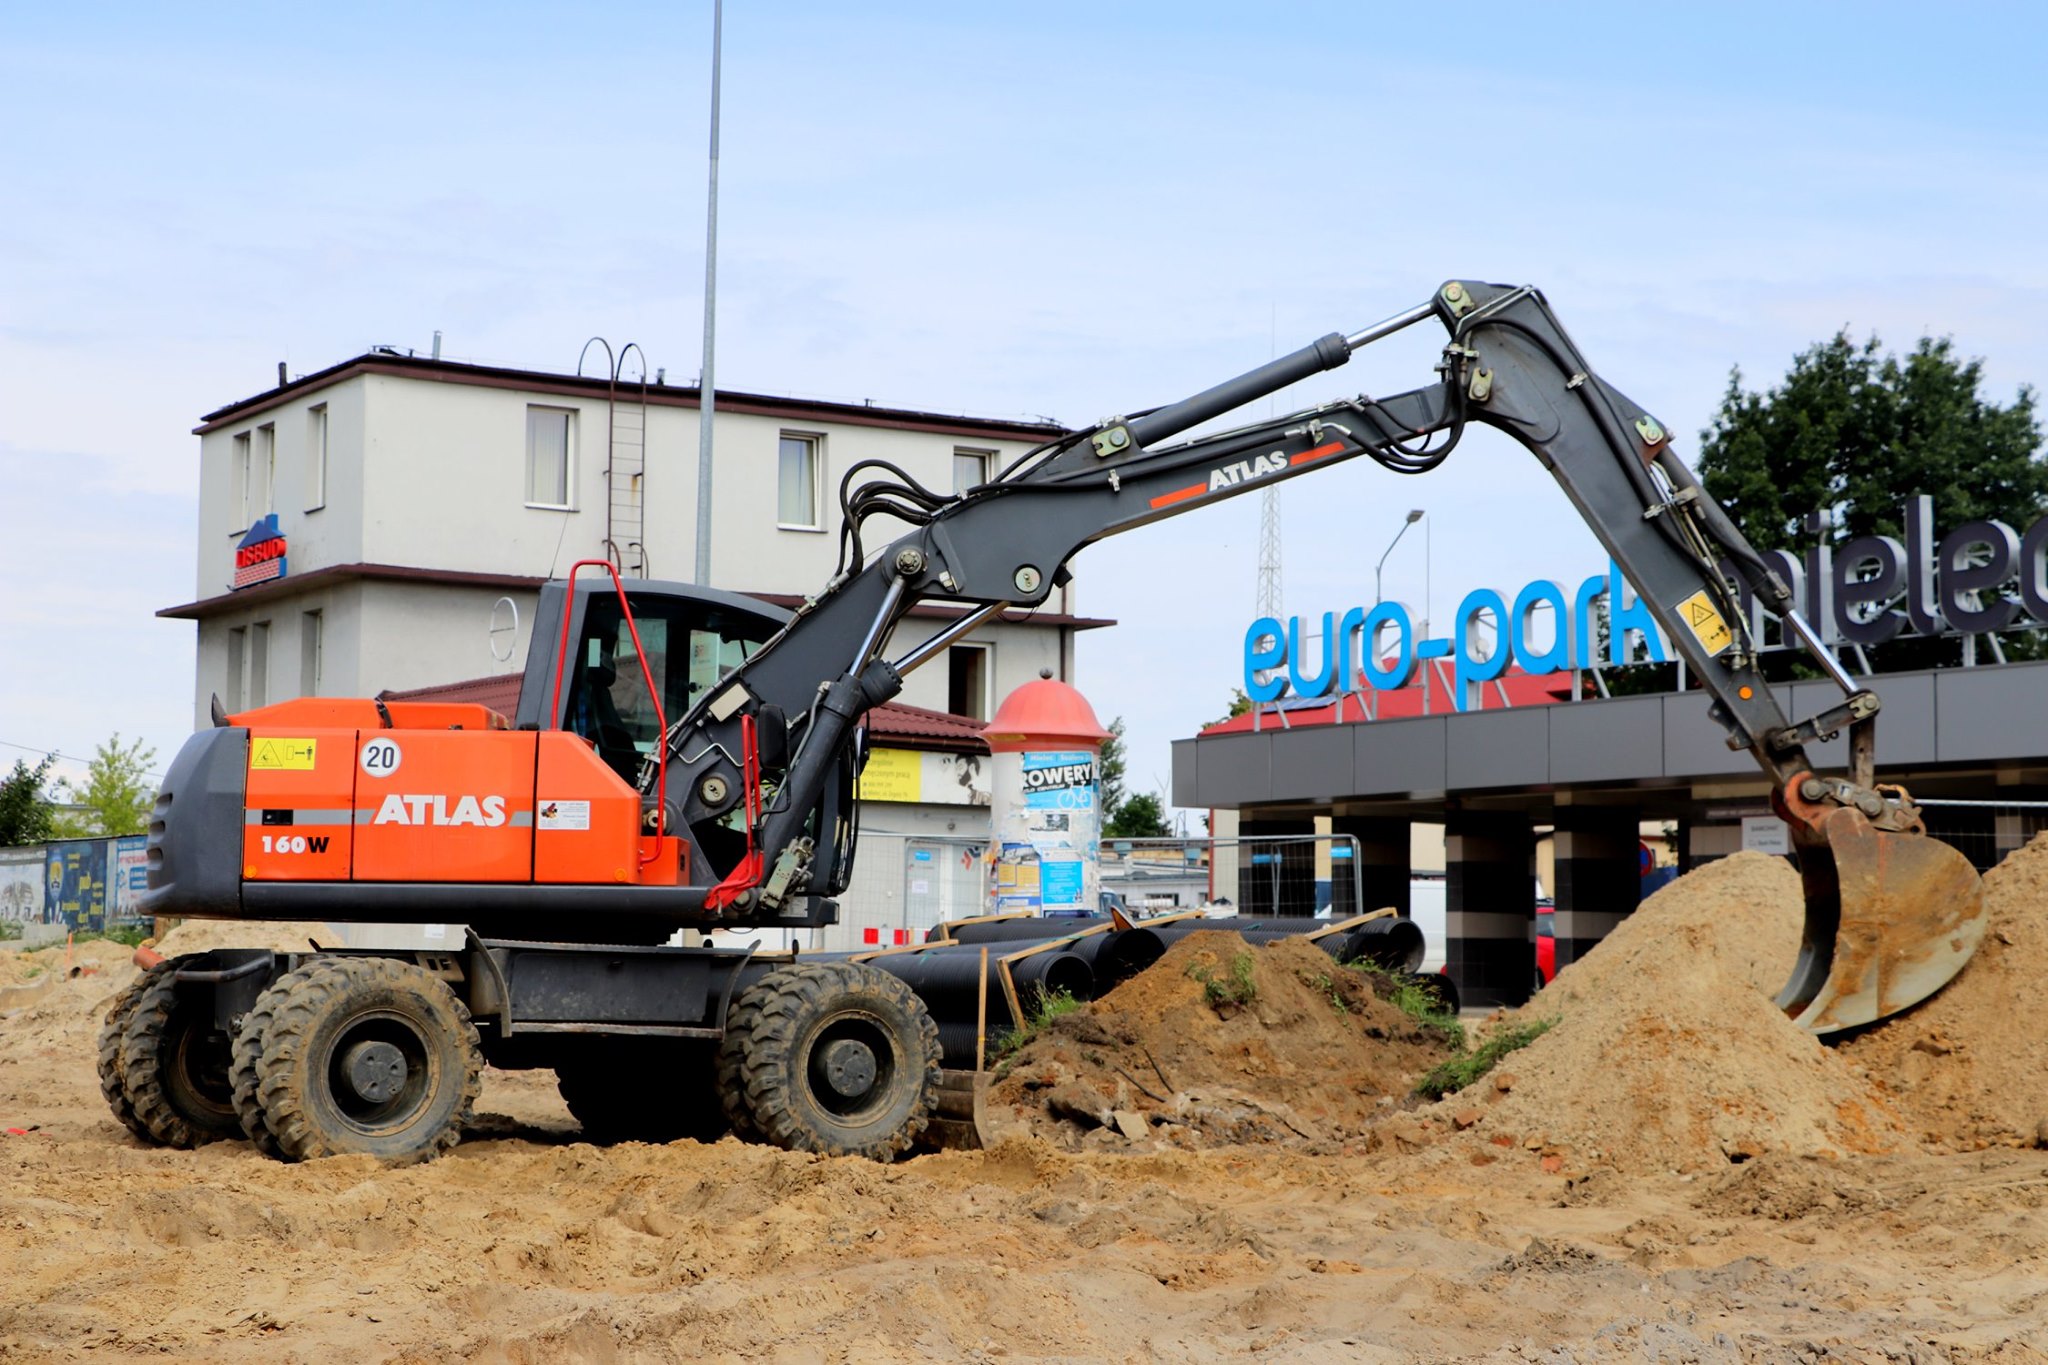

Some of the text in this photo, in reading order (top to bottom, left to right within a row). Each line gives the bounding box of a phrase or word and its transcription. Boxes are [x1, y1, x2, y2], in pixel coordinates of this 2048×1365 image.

[1209, 450, 1288, 492] ATLAS
[1244, 554, 1670, 712] euro-park
[366, 745, 396, 769] 20
[374, 794, 506, 828] ATLAS
